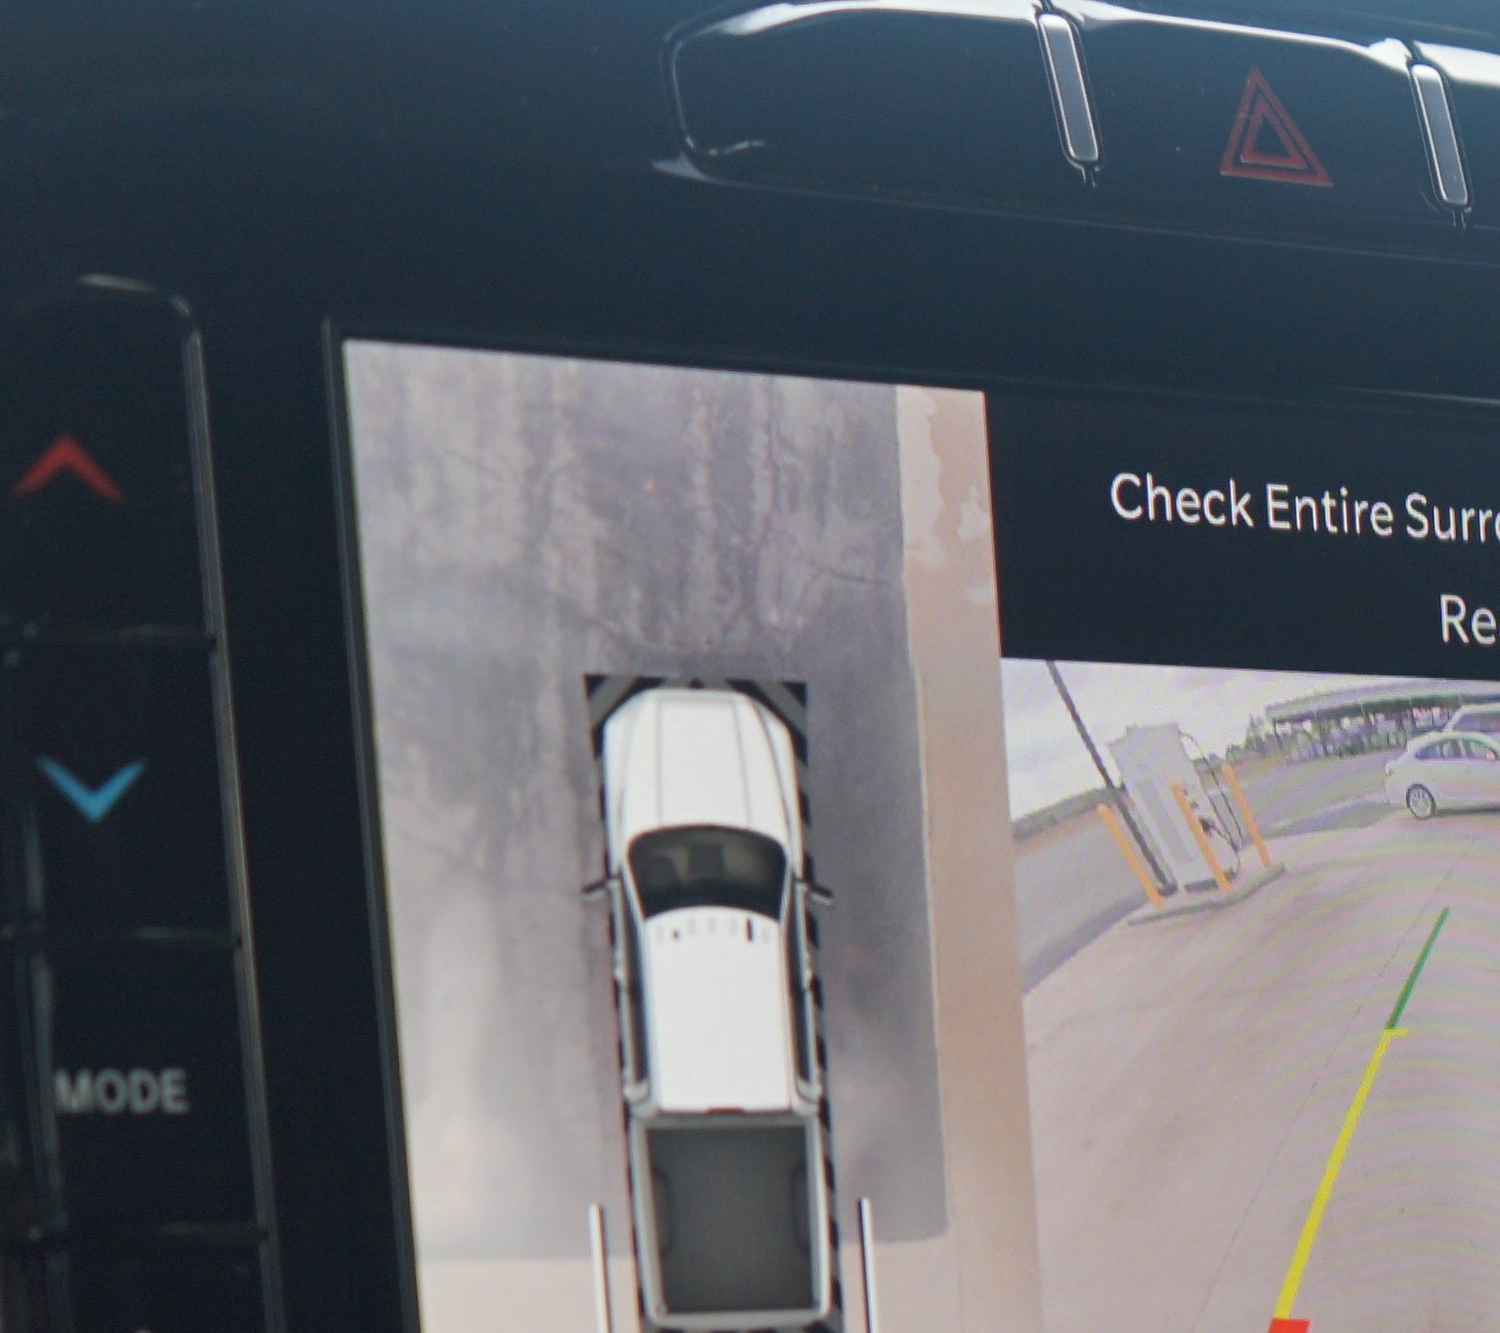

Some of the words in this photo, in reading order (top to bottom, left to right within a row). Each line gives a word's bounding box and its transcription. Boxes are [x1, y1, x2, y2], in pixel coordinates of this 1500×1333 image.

[1109, 472, 1256, 530] Check
[1266, 484, 1395, 539] Entire
[54, 1069, 191, 1116] MODE
